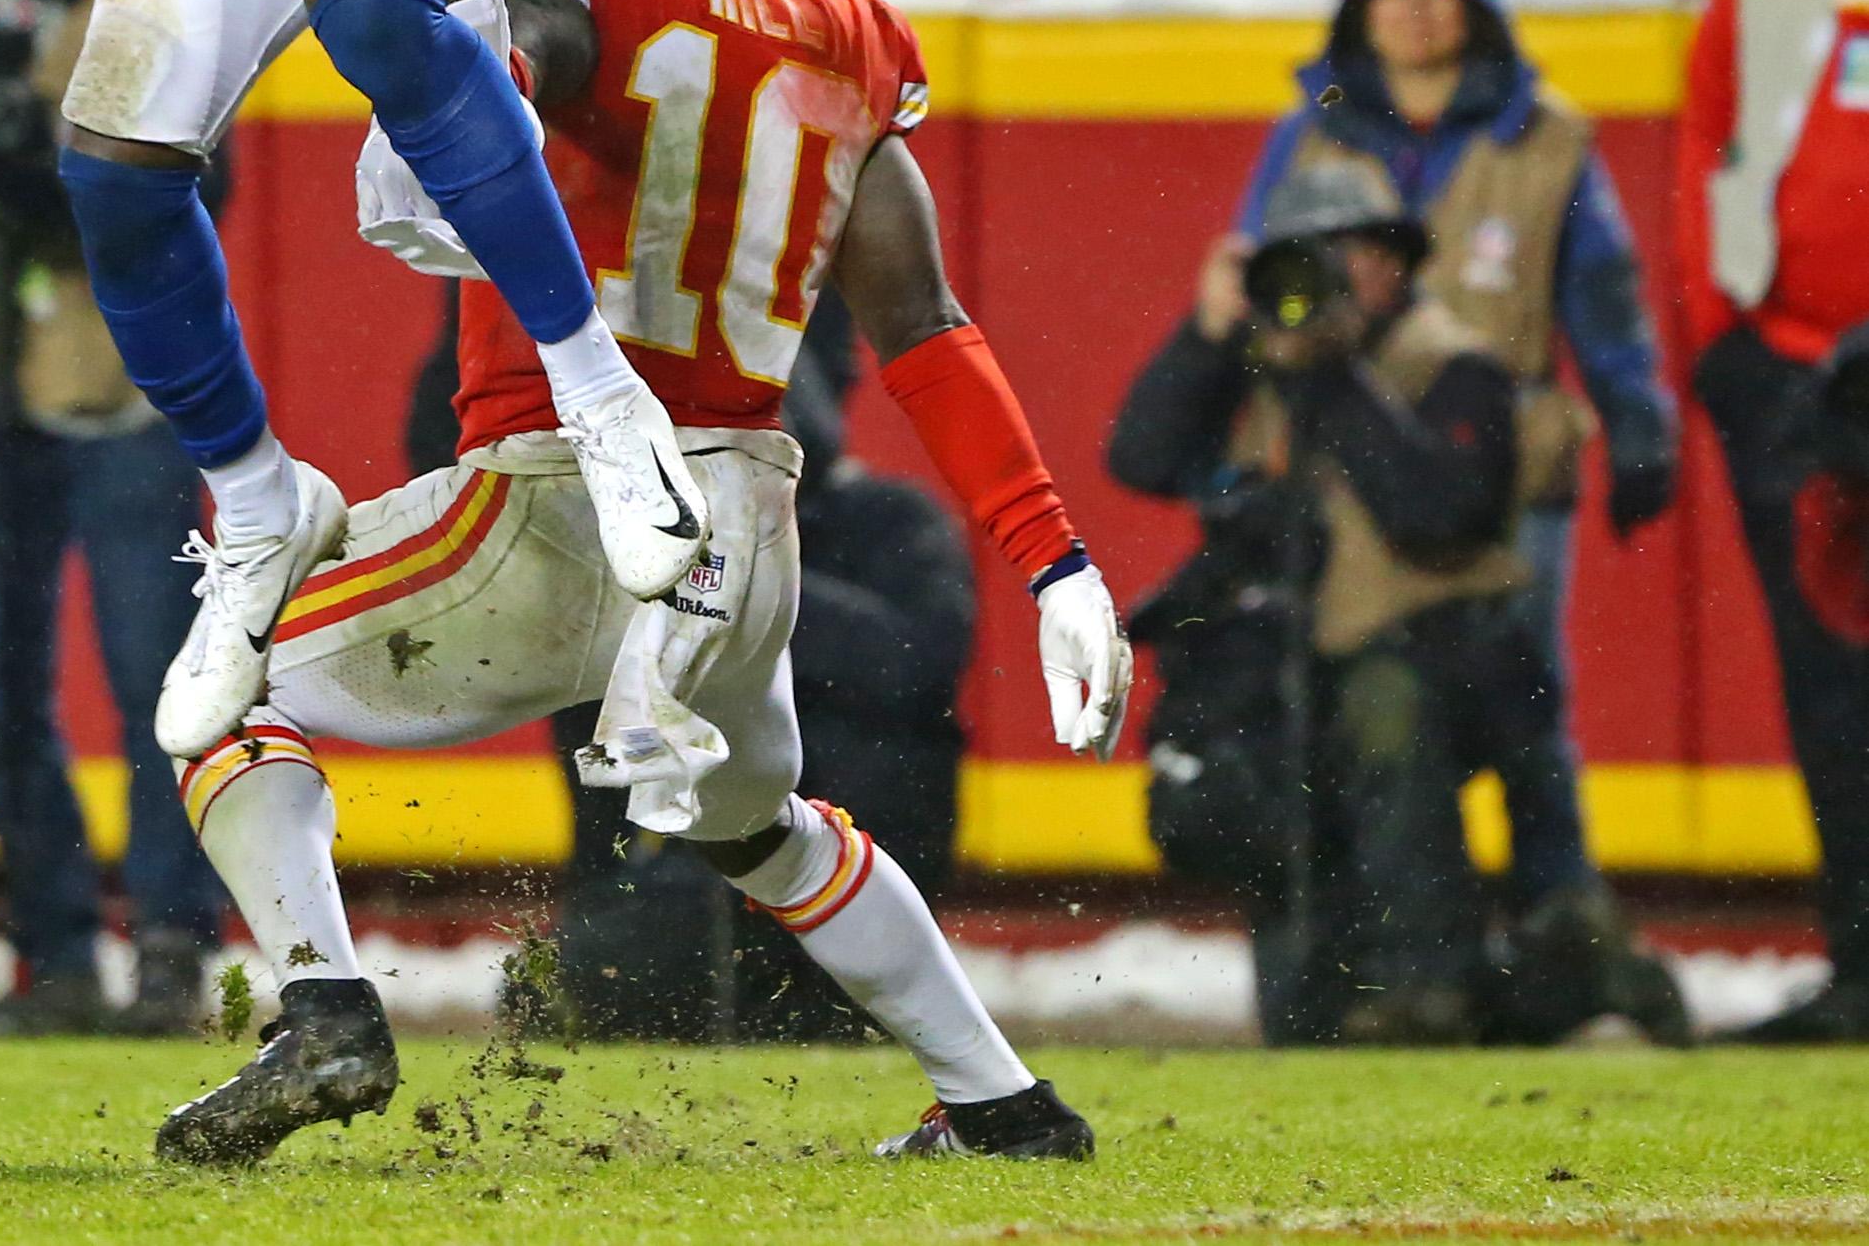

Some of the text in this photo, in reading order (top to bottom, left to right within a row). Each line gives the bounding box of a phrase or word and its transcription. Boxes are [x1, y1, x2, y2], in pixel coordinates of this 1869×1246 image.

[596, 21, 878, 388] 10
[689, 566, 719, 589] NFL
[674, 596, 728, 622] Wilson
